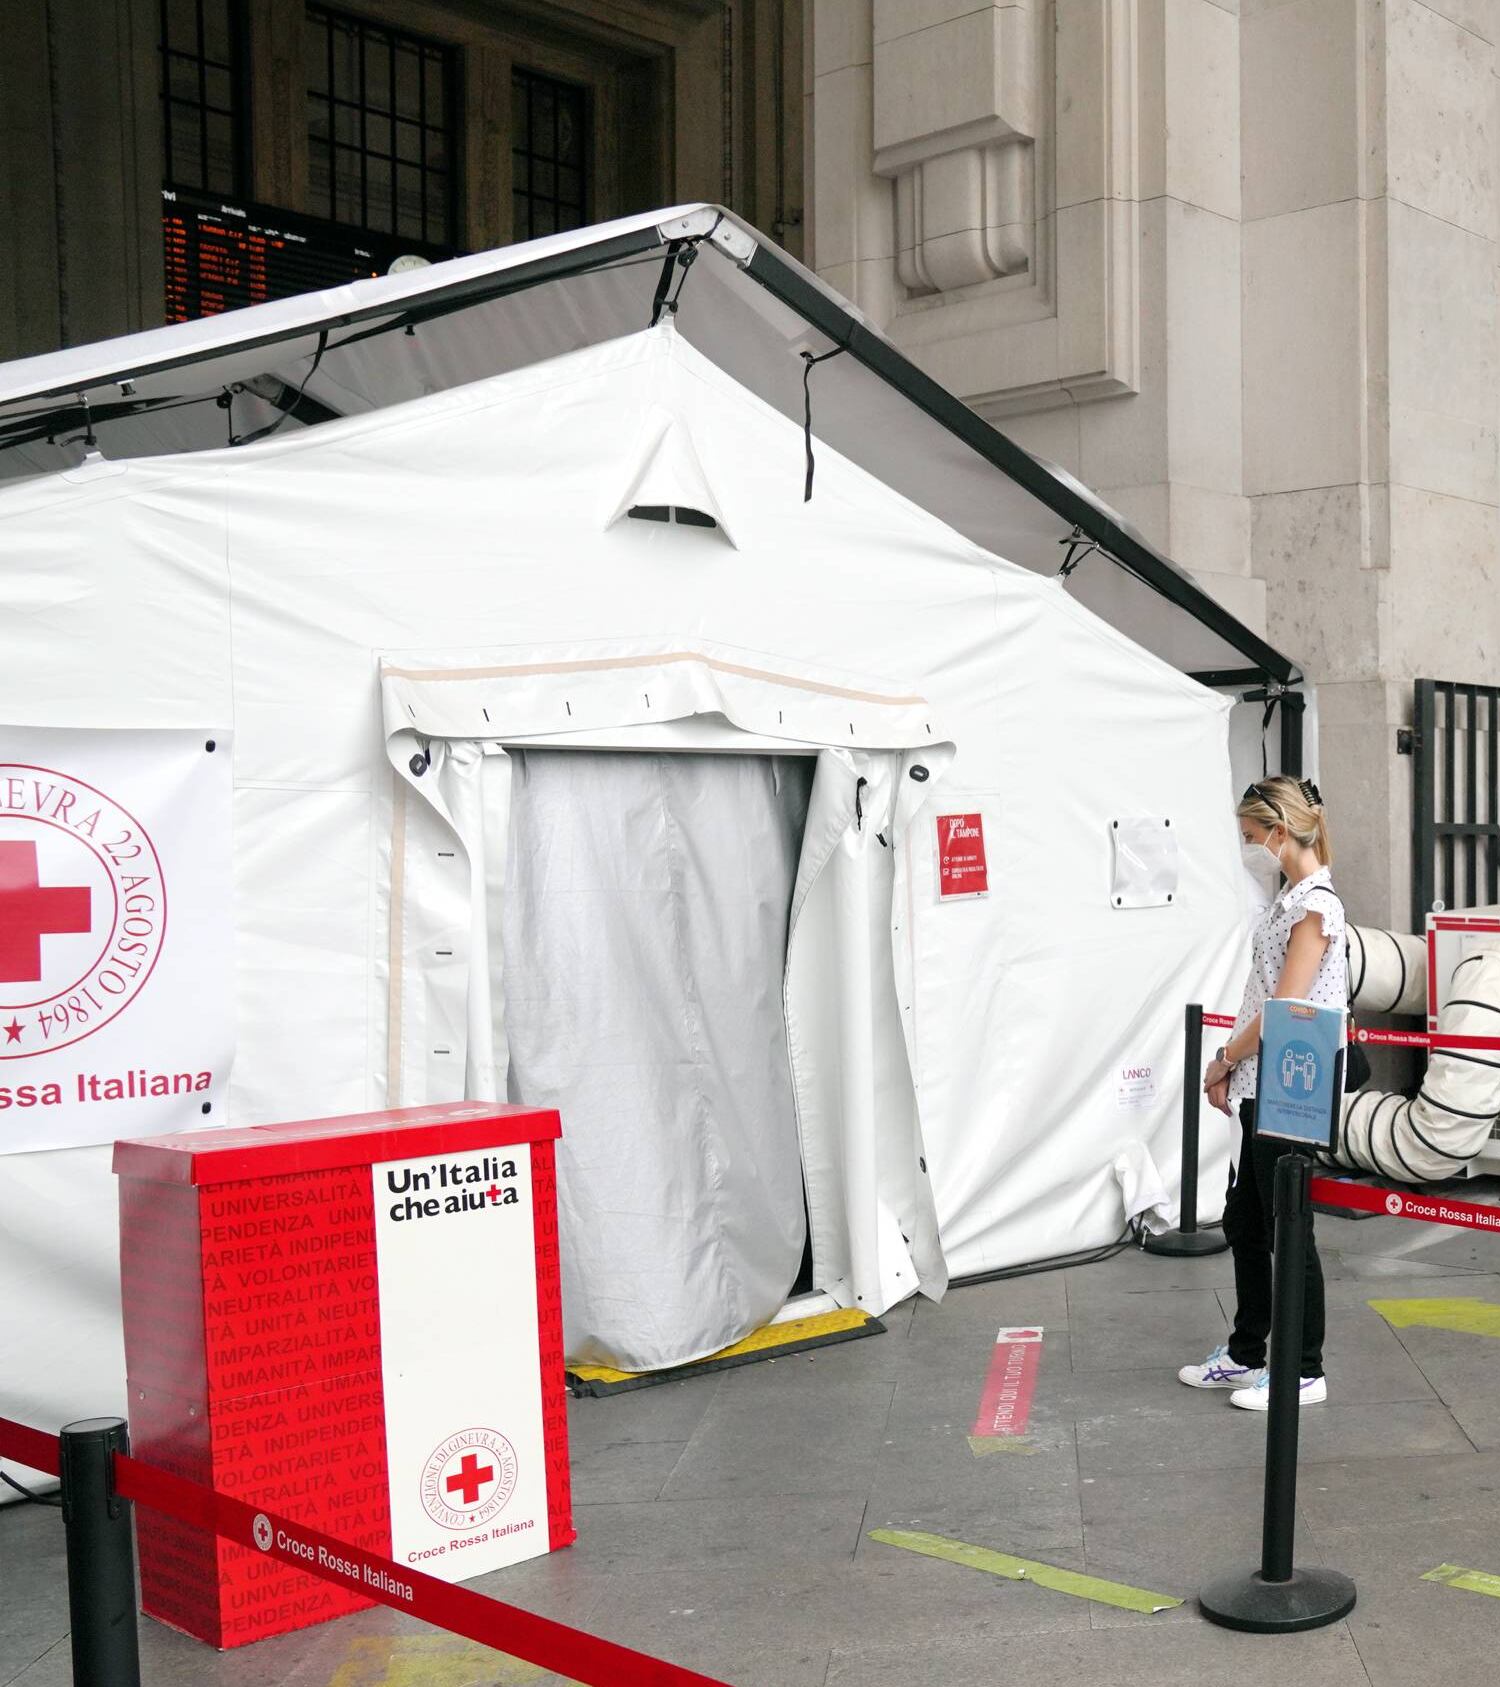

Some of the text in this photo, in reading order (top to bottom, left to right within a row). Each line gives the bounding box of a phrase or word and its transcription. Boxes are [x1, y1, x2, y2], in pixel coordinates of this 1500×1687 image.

[102, 830, 142, 866] 22
[99, 875, 155, 995] AGOSTO
[38, 988, 103, 1039] 1864
[1203, 1016, 1219, 1024] Croce
[1388, 1034, 1407, 1042] Rossa
[1408, 1035, 1431, 1044] Italiana
[78, 1069, 213, 1102] Italiana
[1122, 1067, 1151, 1080] LANCO
[211, 1179, 362, 1218] UNIVERSALITÀ
[389, 1184, 519, 1222] che aiuta
[1405, 1201, 1437, 1216] Croce
[1439, 1206, 1473, 1222] Rossa
[207, 1282, 341, 1318] NEUTRALITÀ
[245, 1308, 308, 1336] UNITÀ
[213, 1324, 358, 1368] IMPARZIALITÀ
[221, 1354, 318, 1391] UMANITÀ
[1004, 1366, 1022, 1380] TUO
[424, 1432, 515, 1526] CONVENZIONE DI GINEVRA 22 AGOSTO 1864
[408, 1519, 535, 1563] Croce Rossa Italiana
[276, 1530, 315, 1561] Croce
[318, 1545, 360, 1580] Rossa
[363, 1563, 413, 1601] Italiana
